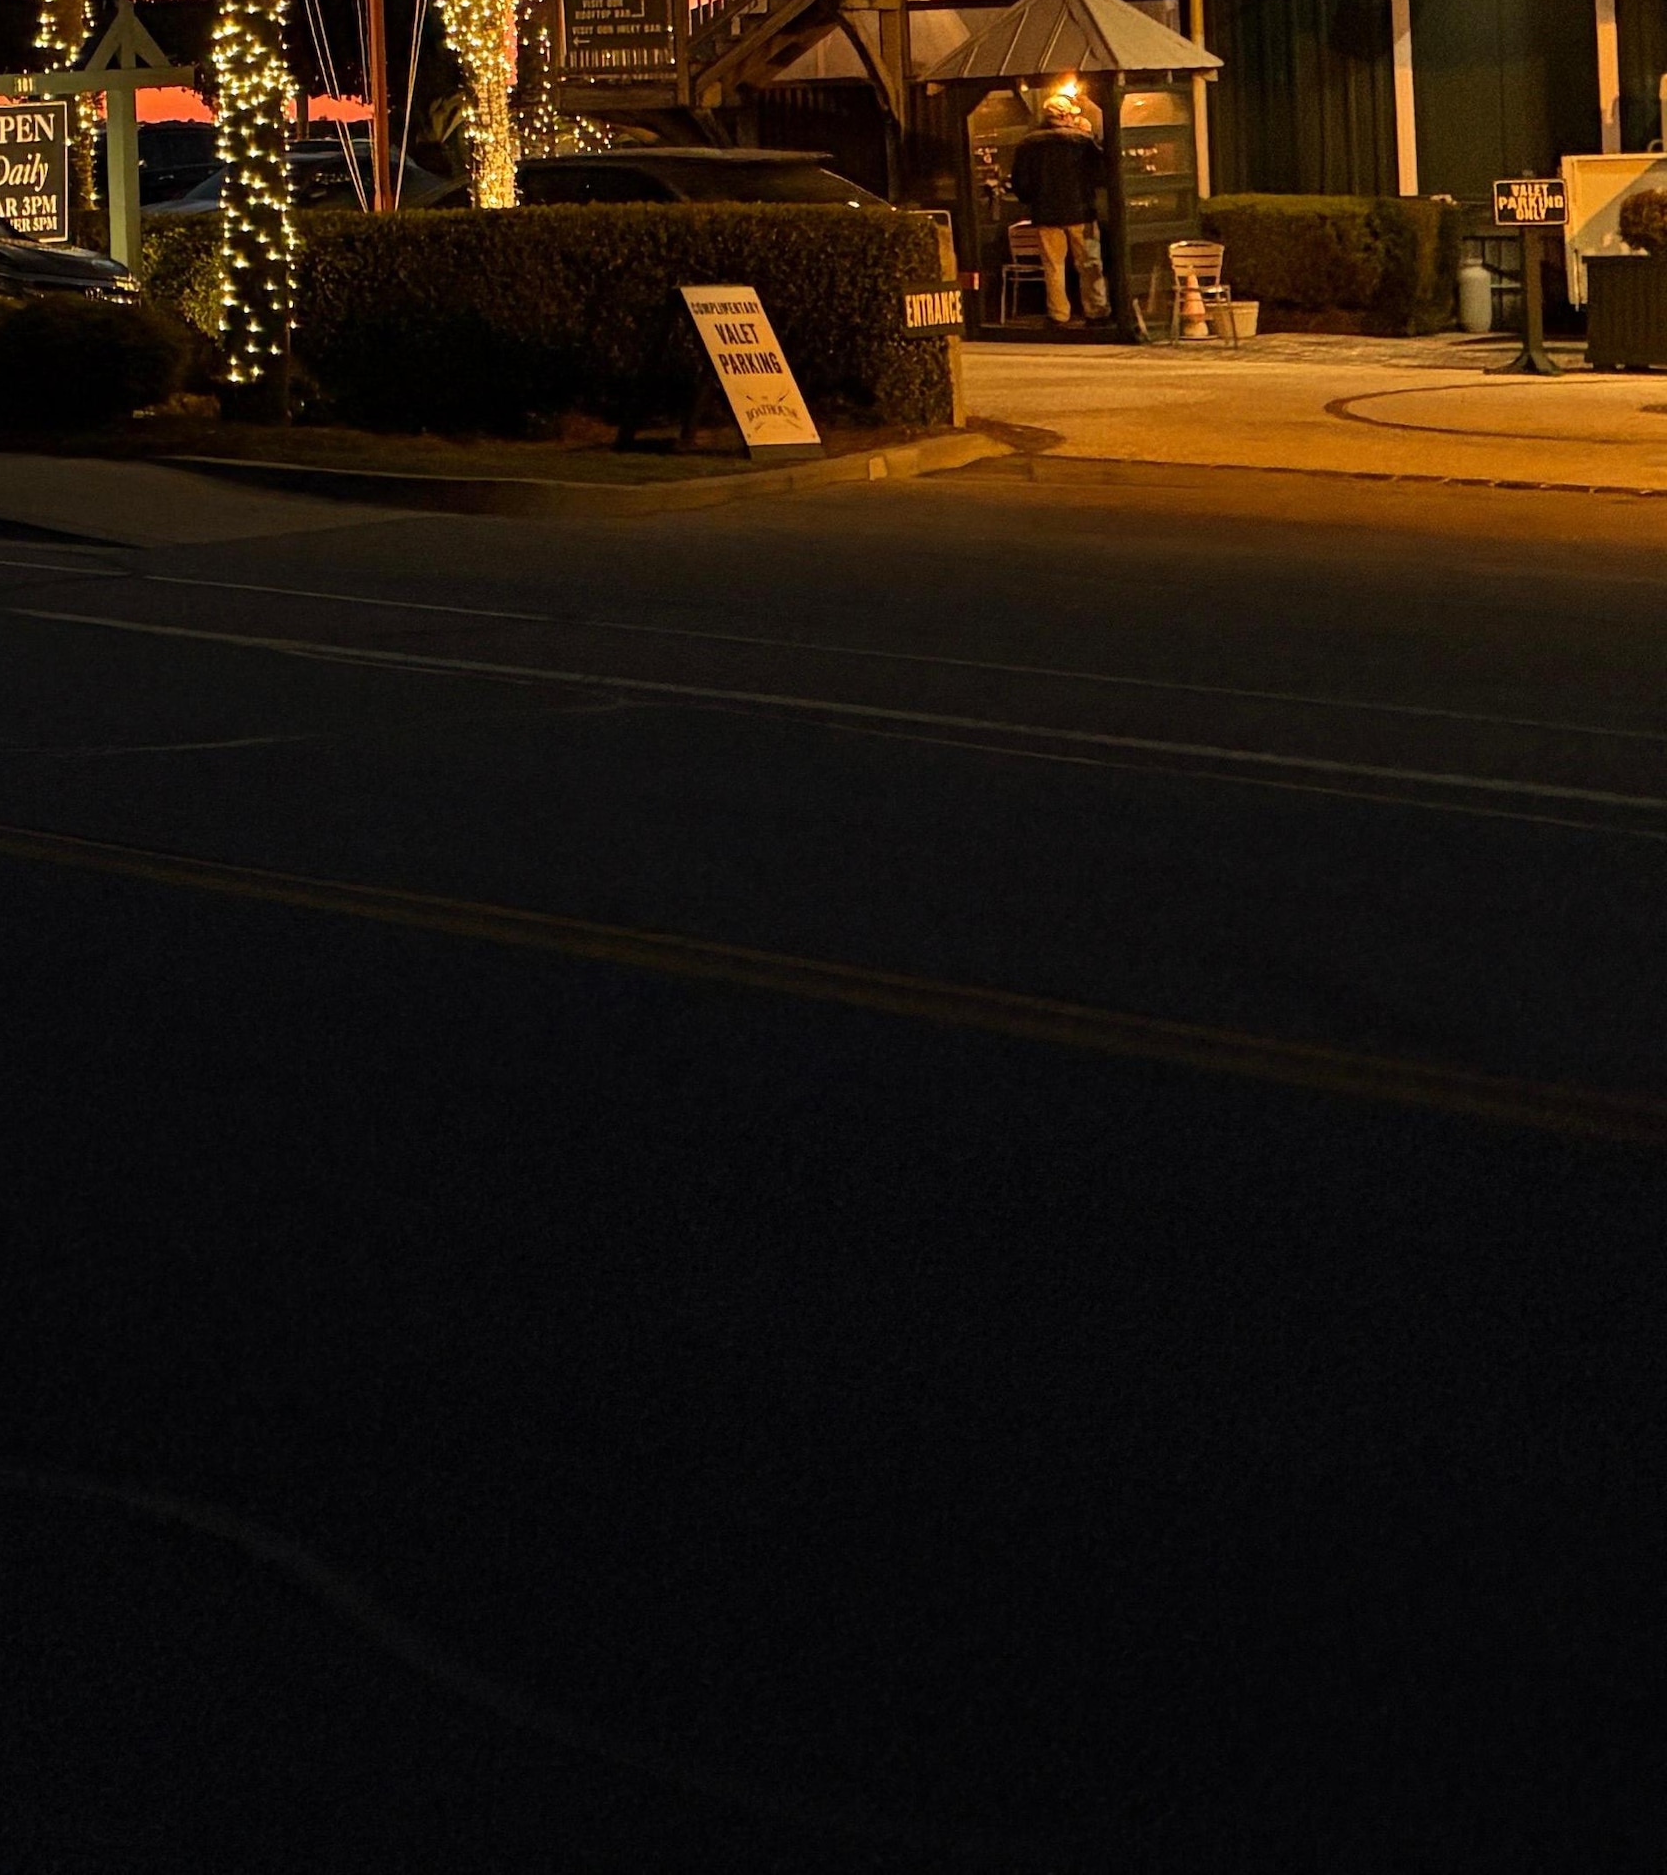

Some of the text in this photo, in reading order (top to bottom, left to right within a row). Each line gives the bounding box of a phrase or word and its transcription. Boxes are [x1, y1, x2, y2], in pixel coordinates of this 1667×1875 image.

[1510, 183, 1549, 197] VALET
[21, 194, 58, 217] 3PM
[1498, 194, 1564, 211] PARKING
[1515, 207, 1547, 221] ONLY
[690, 301, 761, 315] COMPLIMENTARY
[905, 290, 964, 329] ENTRANCE
[714, 323, 759, 346] VALET
[718, 351, 783, 375] PARKING
